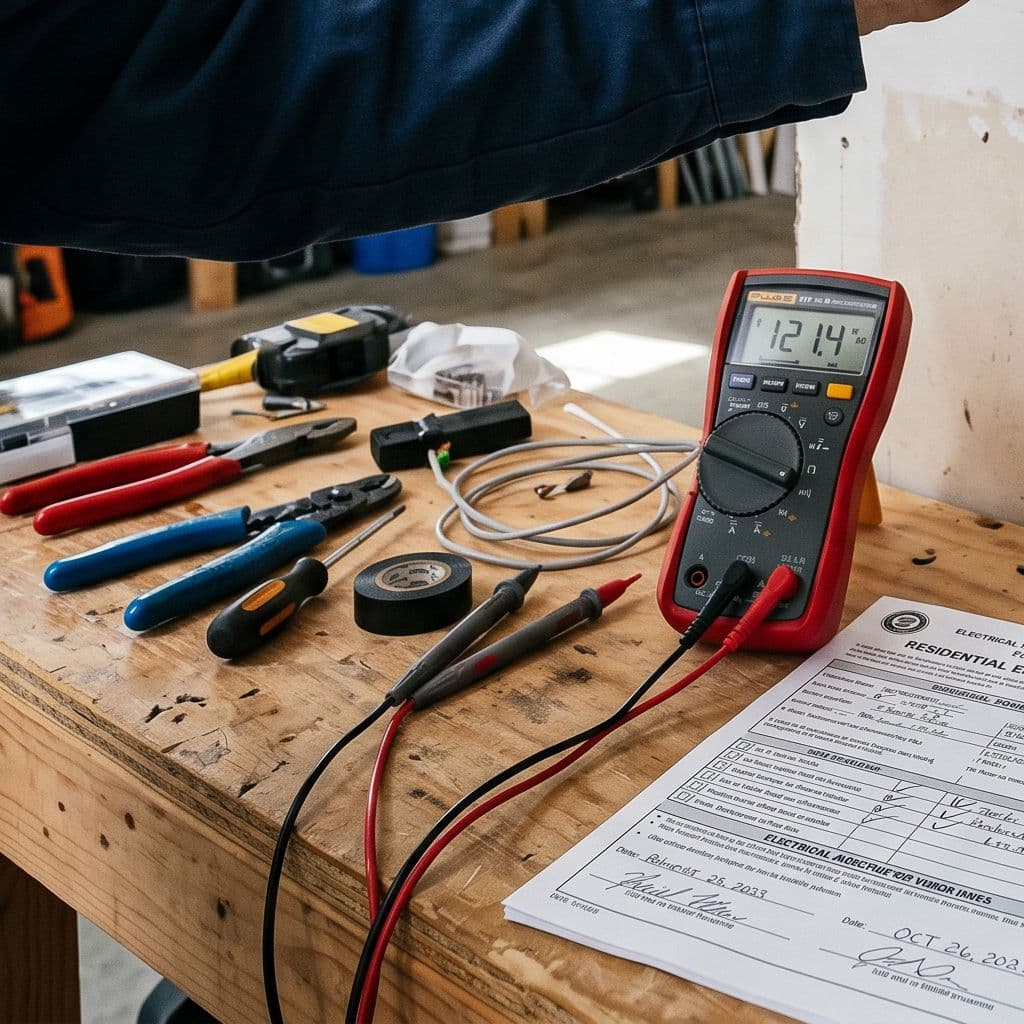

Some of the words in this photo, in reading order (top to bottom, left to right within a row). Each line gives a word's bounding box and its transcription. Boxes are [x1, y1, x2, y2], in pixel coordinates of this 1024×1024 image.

[769, 319, 846, 357] 121.4
[955, 627, 1018, 648] ELECTRICAL
[904, 640, 1007, 670] RESIDENTIAL
[841, 915, 866, 930] Date:
[894, 927, 941, 948] OCT
[944, 941, 974, 962] 26,
